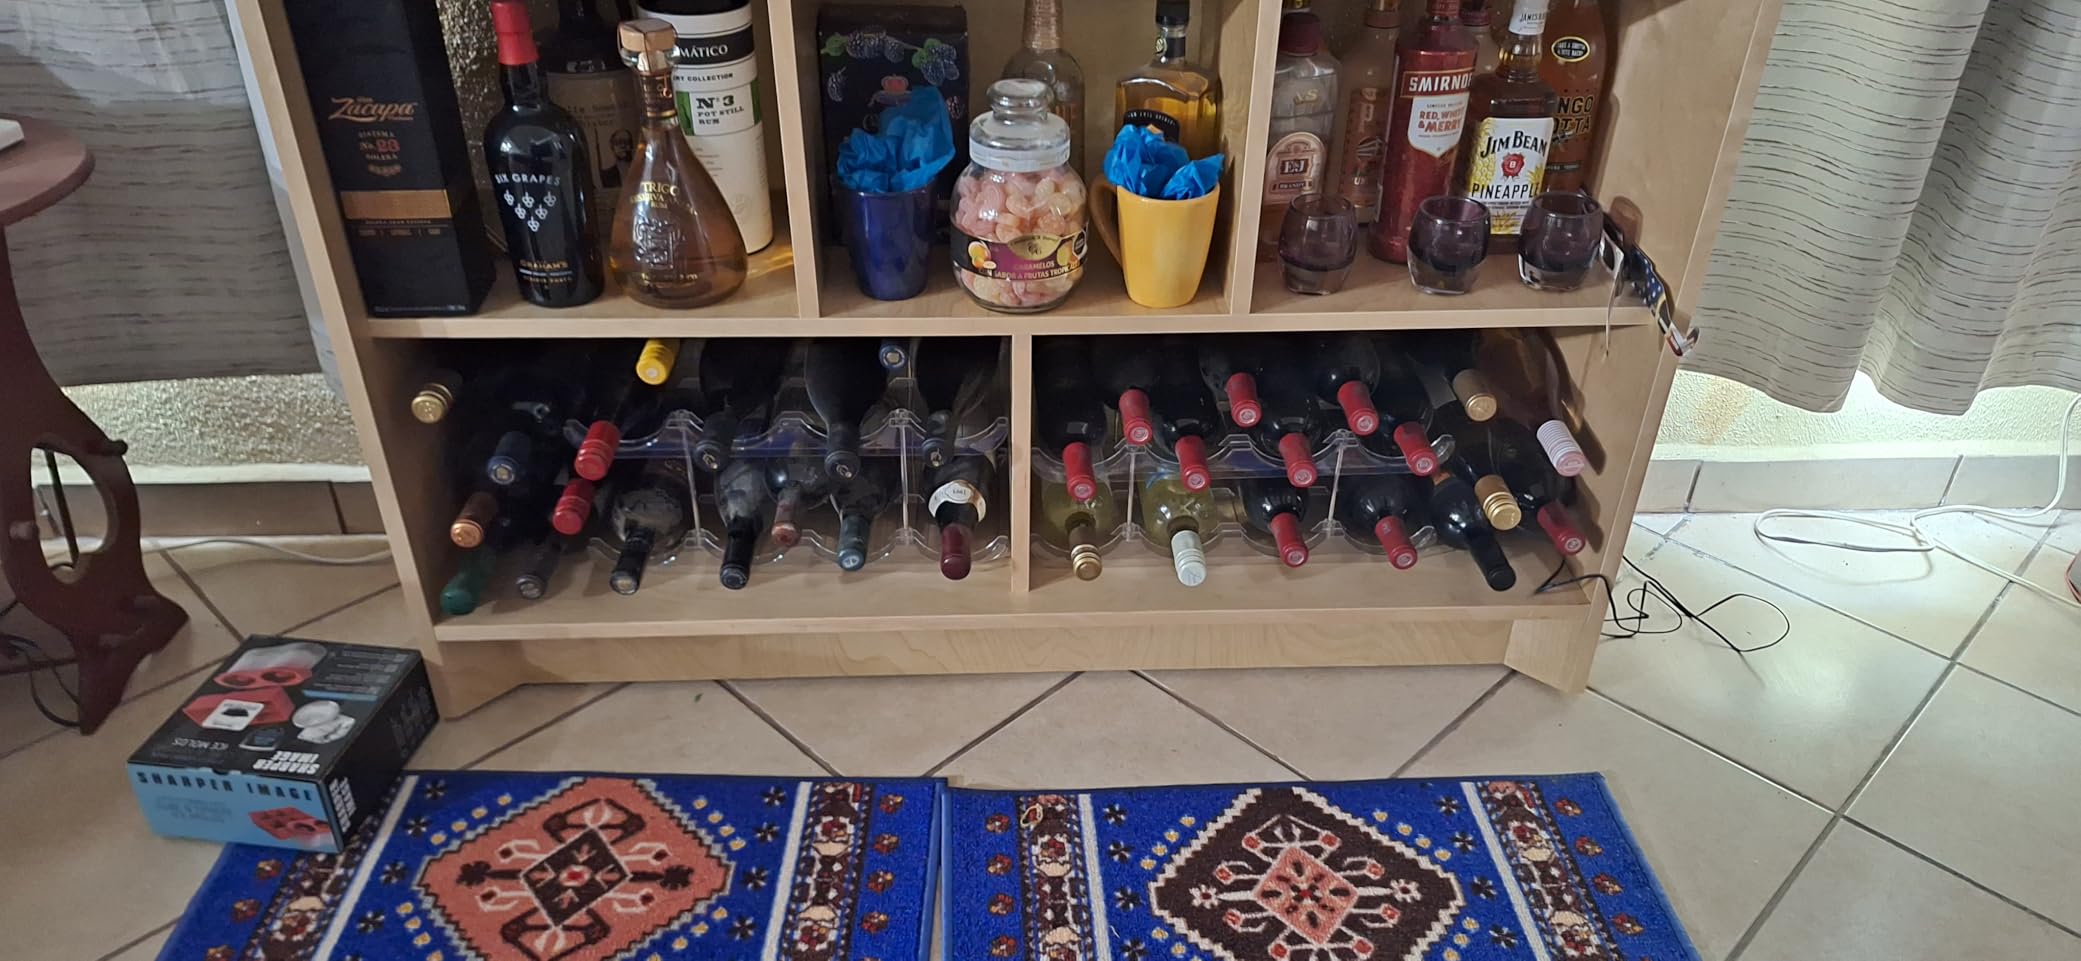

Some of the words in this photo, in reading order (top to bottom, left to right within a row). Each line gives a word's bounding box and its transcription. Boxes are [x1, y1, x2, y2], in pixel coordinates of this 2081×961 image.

[680, 44, 729, 59] MÁTICO
[328, 97, 419, 122] Zacapa
[722, 95, 735, 107] 3
[1556, 95, 1594, 114] NGO
[1480, 136, 1511, 159] JIM
[511, 173, 561, 187] GRAPES
[252, 758, 321, 775] SHARPER
[136, 771, 234, 793] SHARPER
[247, 782, 313, 802] IMAGE
